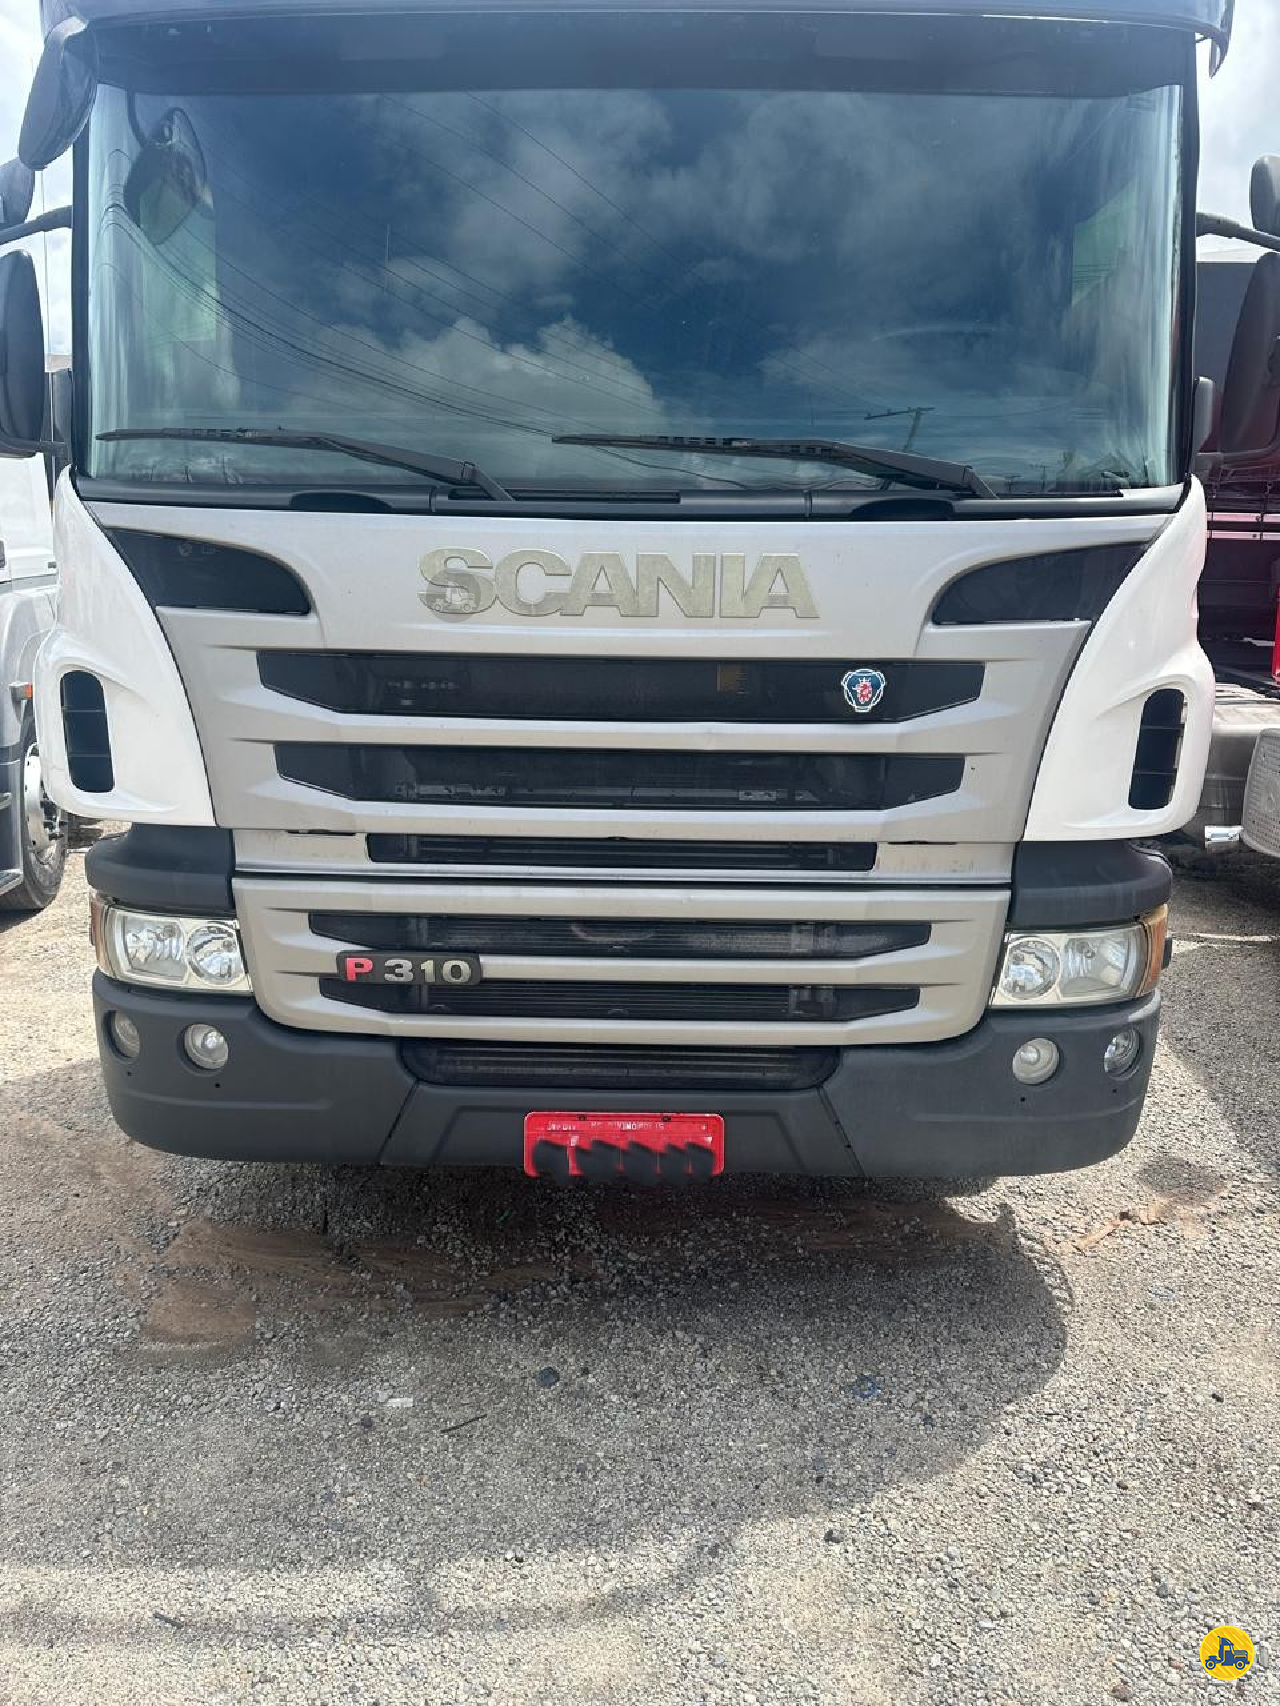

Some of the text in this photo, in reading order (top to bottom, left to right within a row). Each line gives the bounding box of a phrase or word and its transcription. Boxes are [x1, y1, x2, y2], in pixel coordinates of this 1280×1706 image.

[417, 547, 820, 618] SCANIA
[345, 957, 471, 983] P 310
